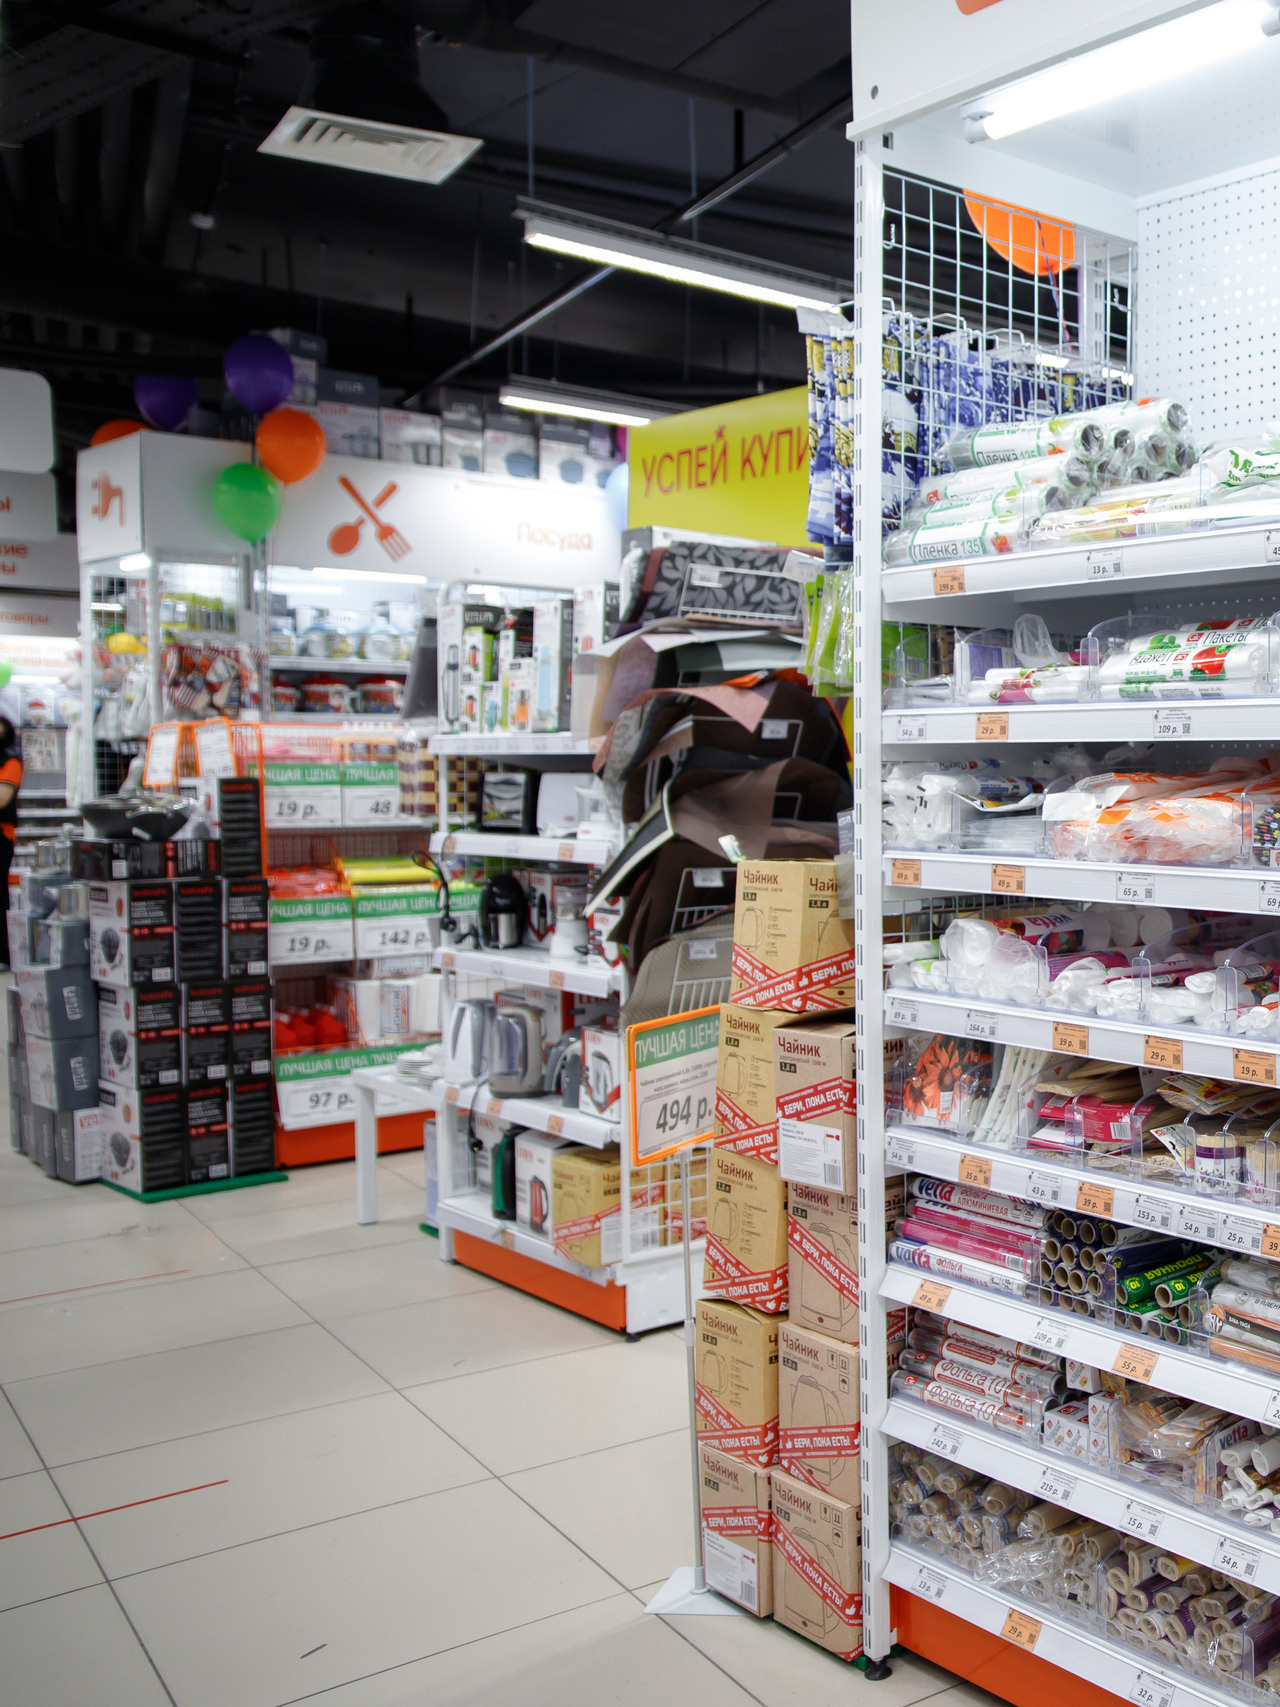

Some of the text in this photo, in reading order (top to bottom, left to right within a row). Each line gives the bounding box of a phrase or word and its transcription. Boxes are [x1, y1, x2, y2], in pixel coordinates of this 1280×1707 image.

[642, 425, 728, 498] УСПЕЙ
[976, 451, 1019, 467] Пленка
[517, 523, 594, 551] Посуда
[913, 538, 981, 559] Пленка 135
[1093, 565, 1100, 574] 13
[1203, 631, 1248, 645] Пакеты
[1158, 724, 1169, 734] 109
[305, 768, 338, 782] ЦЕНА
[345, 768, 394, 780] ЛУЧШАЯ
[275, 801, 297, 817] 19
[370, 801, 393, 814] 48
[743, 870, 779, 885] Чайник
[1123, 888, 1131, 896] 65
[316, 902, 348, 915] ЦЕНА
[358, 899, 408, 912] ЛУЧШАЯ
[1267, 897, 1277, 906] 69
[288, 937, 309, 952] 19
[379, 930, 410, 947] 142
[811, 964, 840, 982] БЕРИ,
[726, 1014, 760, 1034] Чайник
[635, 1020, 720, 1064] ЛУЧШАЯ ЦЕНА
[778, 1037, 821, 1057] Чайник
[1059, 1038, 1067, 1046] 39
[1151, 1051, 1159, 1059] 29
[279, 1060, 333, 1076] ЛУЧШАЯ
[335, 1056, 368, 1071] ЦЕНА
[1241, 1066, 1249, 1075] 19
[309, 1092, 332, 1109] 97
[784, 1102, 805, 1115] БЕРИ,
[805, 1095, 825, 1109] ПОКА
[656, 1095, 692, 1134] 494
[717, 1159, 753, 1182] Чайник
[792, 1183, 829, 1207] Чайник
[918, 1178, 956, 1202] vetta
[960, 1189, 988, 1201] ФОЛЬГА
[957, 1196, 1009, 1216] АЛЮМИНИЕВАЯ
[1083, 1199, 1091, 1207] 39
[1137, 1210, 1149, 1219] 153
[1184, 1222, 1193, 1231] 54
[1228, 1232, 1237, 1241] 25
[1269, 1242, 1278, 1251] 39
[802, 1238, 839, 1279] БЕРИ, ПОКА
[936, 1258, 963, 1272] ФОЛЬГА
[1144, 1254, 1205, 1280] ПРОЧНАЯ
[728, 1285, 748, 1298] ПОКА
[1130, 1280, 1141, 1290] 10
[1175, 1281, 1186, 1291] 10
[702, 1311, 738, 1336] Чайник
[782, 1332, 819, 1361] Чайник
[1122, 1361, 1130, 1370] 55
[941, 1360, 1006, 1394] Фольга 10
[930, 1384, 994, 1421] Фольга 10
[1219, 1422, 1248, 1446] vetta
[721, 1438, 739, 1448] ПОКА
[794, 1436, 850, 1448] БЕРИ, ПОКА ЕСТЬ!
[704, 1454, 739, 1484] Чайник
[775, 1482, 812, 1514] Чайник
[709, 1518, 725, 1528] БЕРИ,
[726, 1517, 743, 1527] ПОКА
[1127, 1517, 1135, 1526] 15
[1221, 1556, 1230, 1565] 54
[784, 1543, 843, 1607] БЕРИ, ПОКА ЕСТЬ!
[1008, 1625, 1016, 1634] 29
[1137, 1688, 1146, 1697] 32
